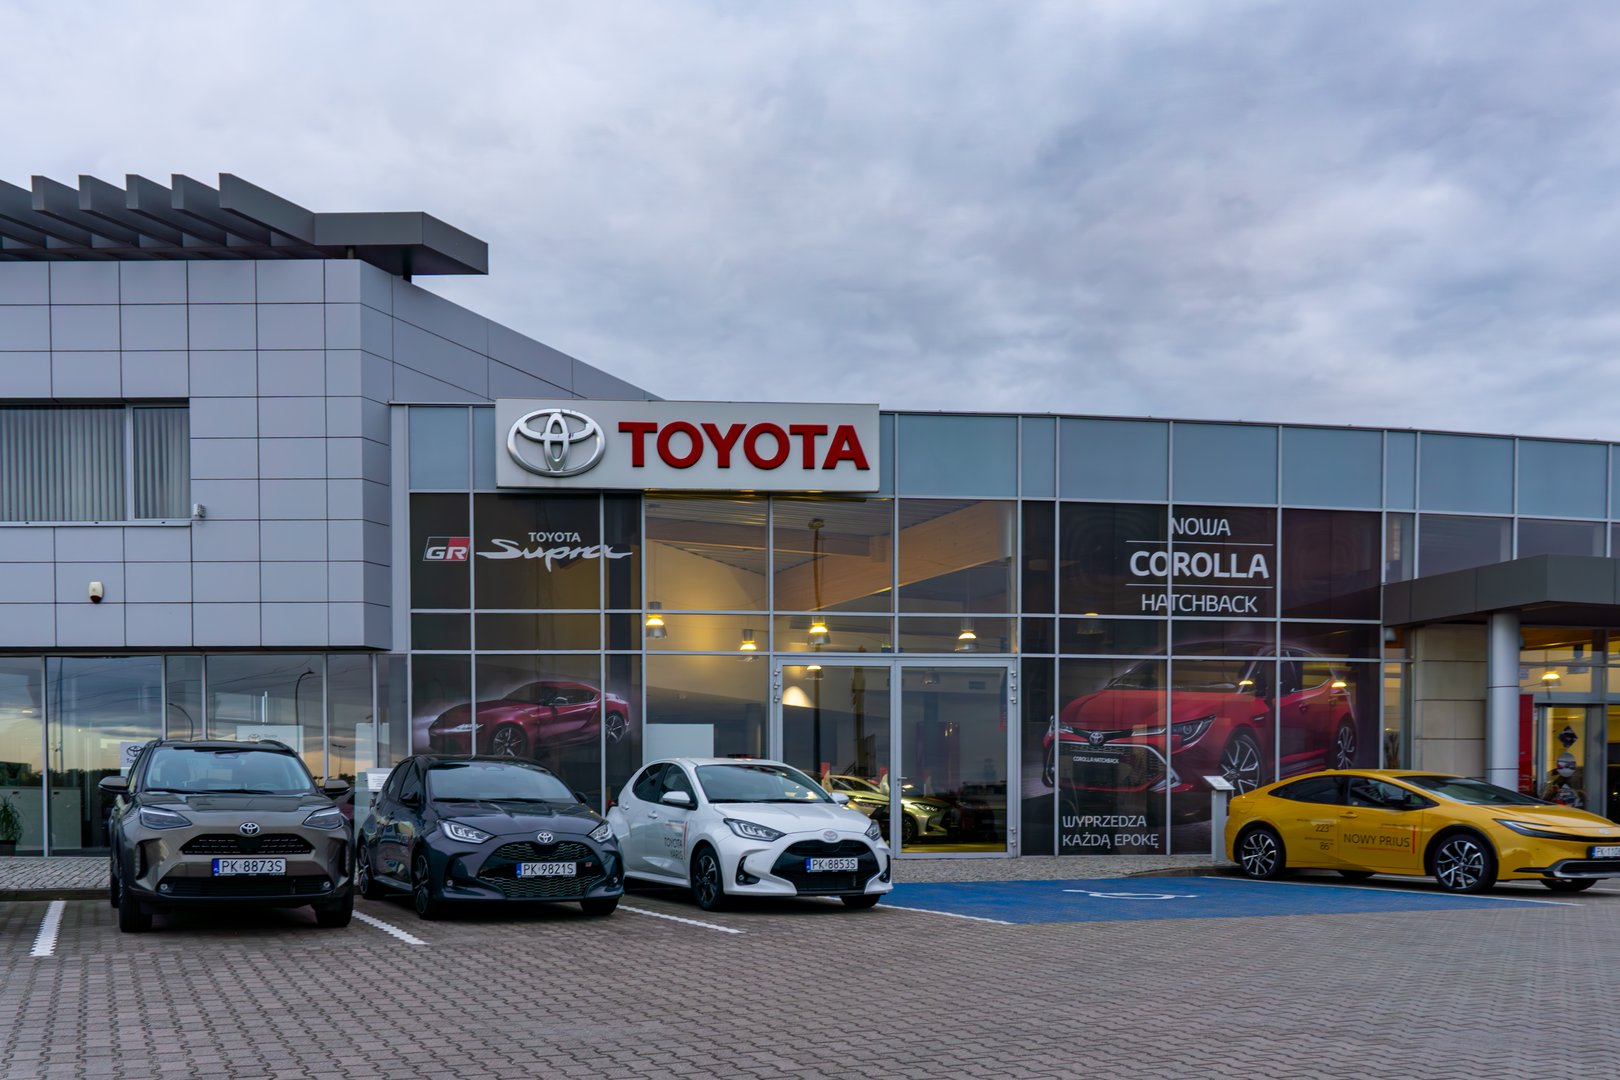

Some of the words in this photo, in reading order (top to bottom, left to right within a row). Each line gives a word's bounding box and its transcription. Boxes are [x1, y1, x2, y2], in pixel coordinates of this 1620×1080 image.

[618, 421, 870, 470] TOYOTA
[1171, 517, 1231, 536] NOWA
[528, 532, 582, 543] TOYOTA
[425, 546, 468, 560] GR
[476, 538, 633, 572] Supra
[1129, 551, 1270, 578] COROLLA
[1141, 593, 1259, 613] HATCHBACK
[1062, 815, 1147, 828] WYPRZEDZA
[1062, 832, 1111, 849] KAŻDĄ
[1114, 834, 1159, 848] EPOKĘ
[1343, 833, 1377, 844] NOWY
[1379, 835, 1410, 848] PRIUS
[221, 860, 238, 873] PK
[243, 860, 282, 872] 8873S
[523, 863, 538, 875] PK
[541, 863, 574, 875] 9821S
[812, 859, 825, 870] PK
[828, 858, 856, 869] 8853S
